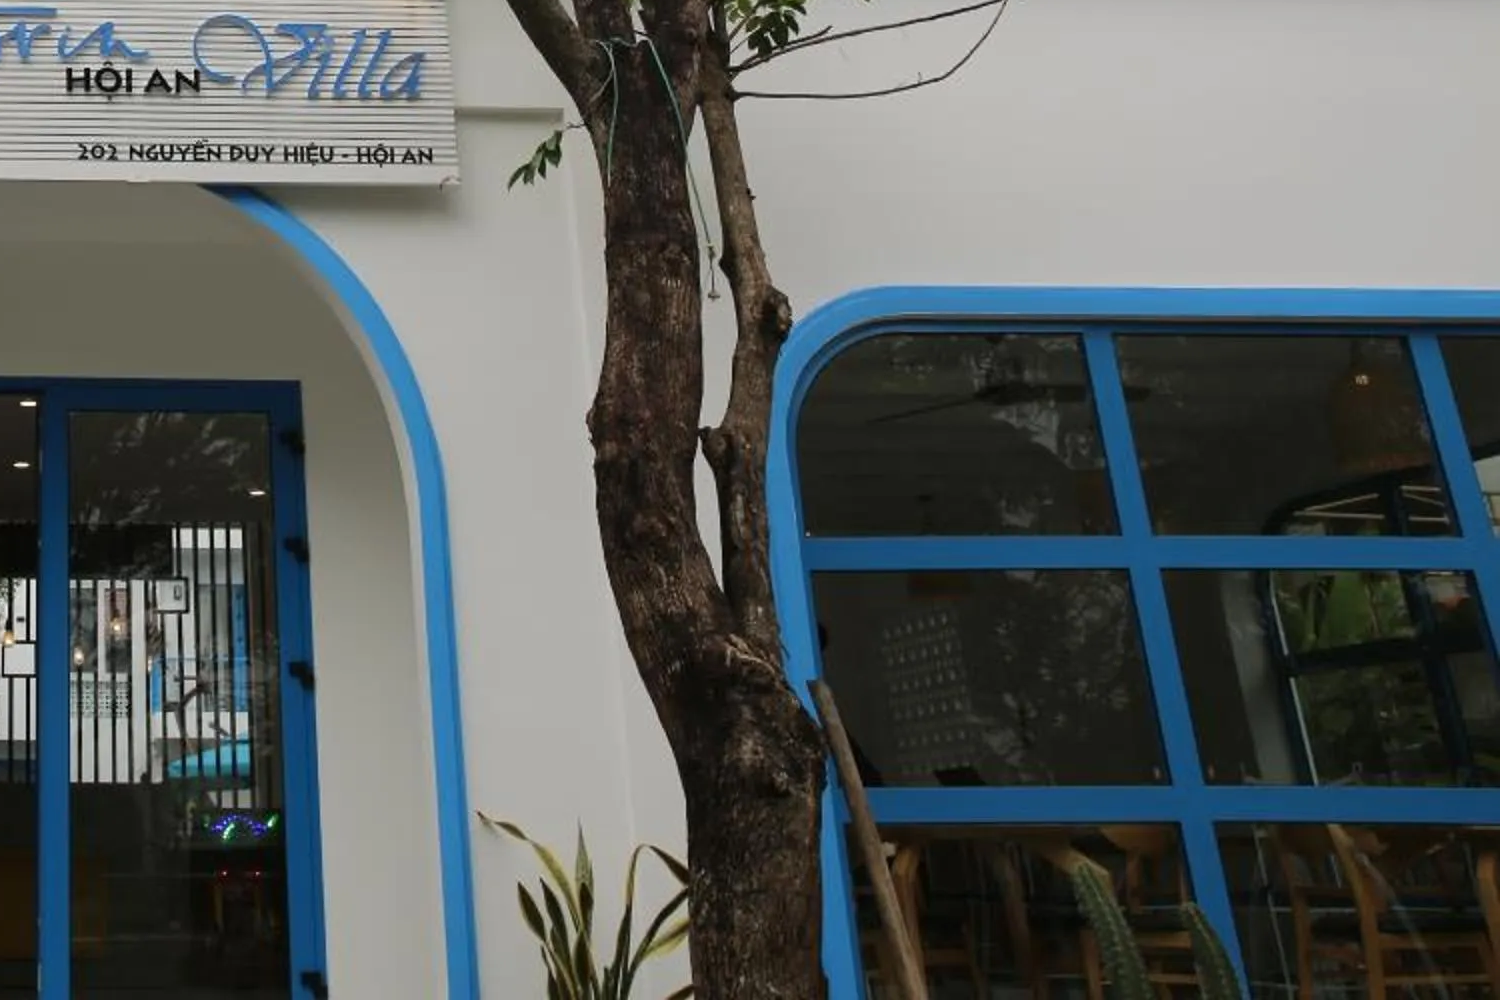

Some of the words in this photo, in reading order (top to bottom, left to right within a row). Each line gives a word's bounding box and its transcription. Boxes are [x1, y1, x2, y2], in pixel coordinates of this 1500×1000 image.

[193, 14, 426, 101] Villa
[65, 61, 133, 101] HỘI
[144, 68, 201, 93] AN
[78, 143, 118, 161] 202
[129, 139, 221, 162] NGUYỄN
[229, 144, 275, 163] DUY
[283, 142, 334, 166] HIỆU
[356, 143, 395, 168] HỘI
[402, 147, 433, 164] AN
